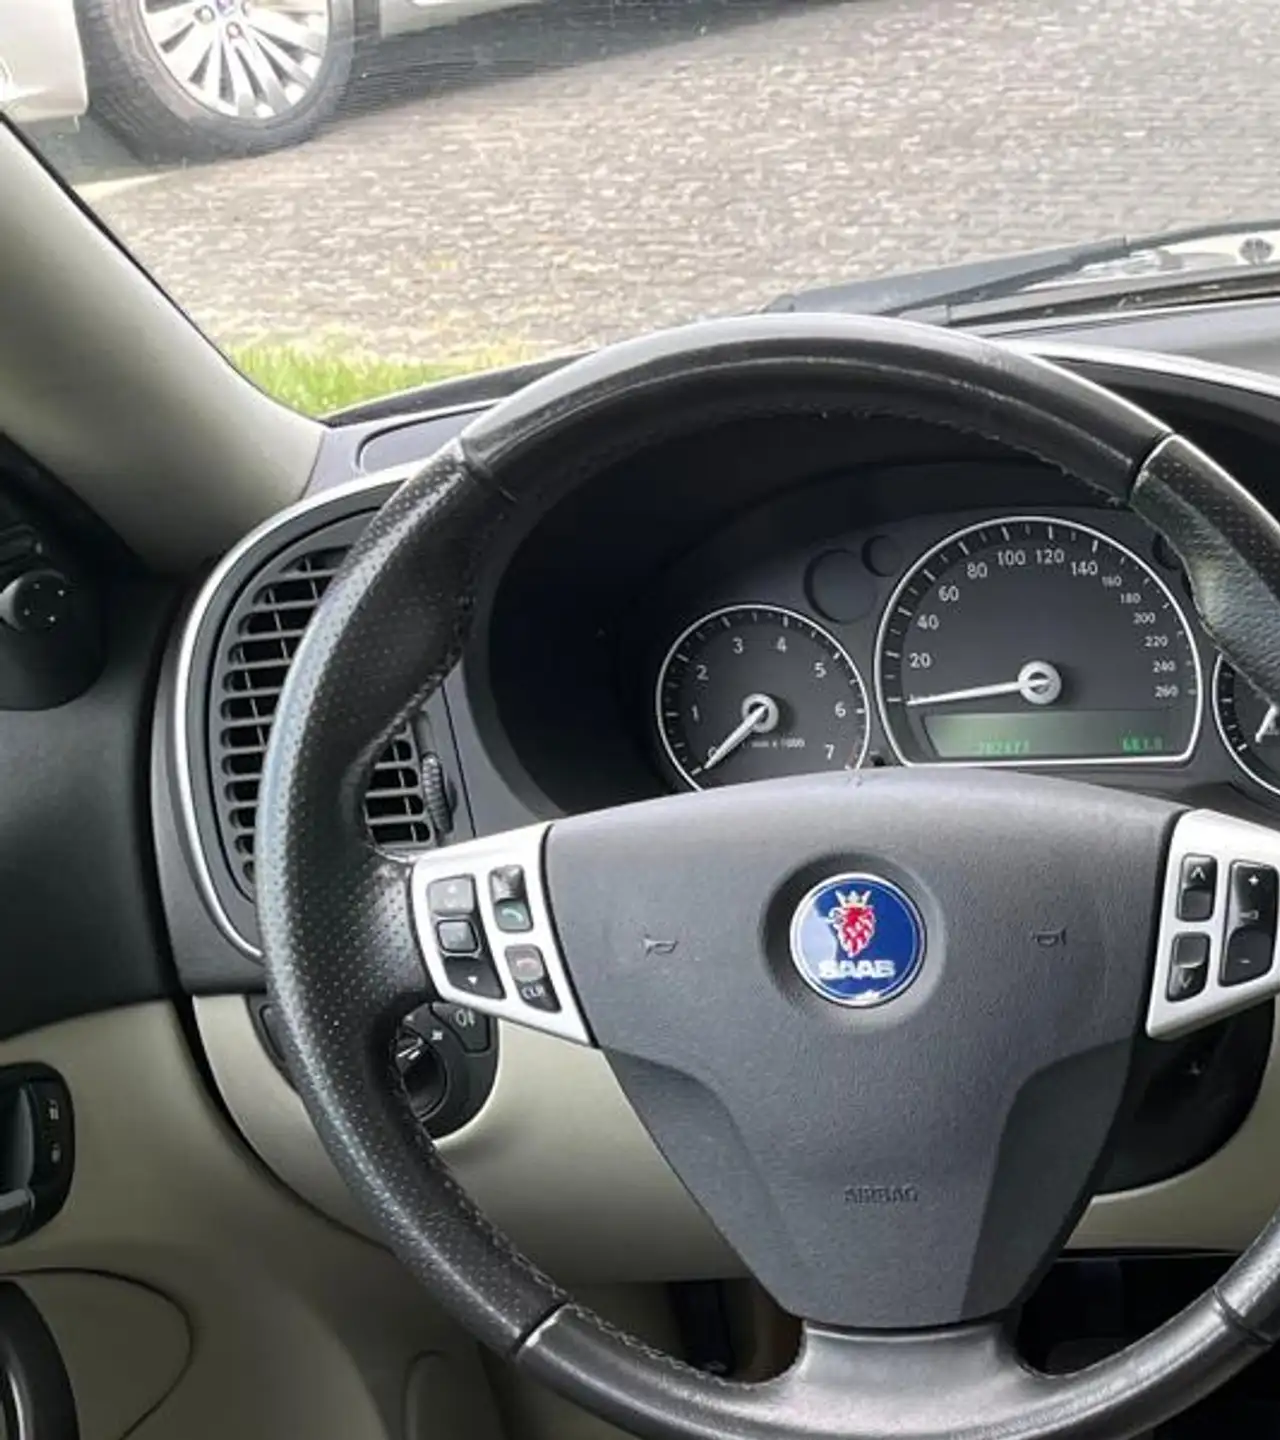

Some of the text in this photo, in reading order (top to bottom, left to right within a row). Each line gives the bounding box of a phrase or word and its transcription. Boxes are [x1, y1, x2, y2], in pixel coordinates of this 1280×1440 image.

[998, 551, 1025, 566] 100
[1036, 549, 1064, 563] 120
[967, 563, 988, 579] 80
[1071, 560, 1098, 576] 140
[938, 585, 959, 602] 60
[1119, 592, 1141, 604] 180
[917, 614, 939, 630] 40
[1133, 611, 1156, 624] 200
[733, 637, 743, 654] 3
[776, 636, 788, 653] 4
[1144, 635, 1169, 648] 220
[909, 653, 931, 668] 20
[1153, 660, 1176, 673] 240
[696, 665, 709, 681] 2
[814, 662, 827, 678] 5
[1155, 685, 1179, 698] 260
[835, 702, 846, 718] 6
[825, 744, 835, 761] 7
[819, 959, 896, 979] SAAB
